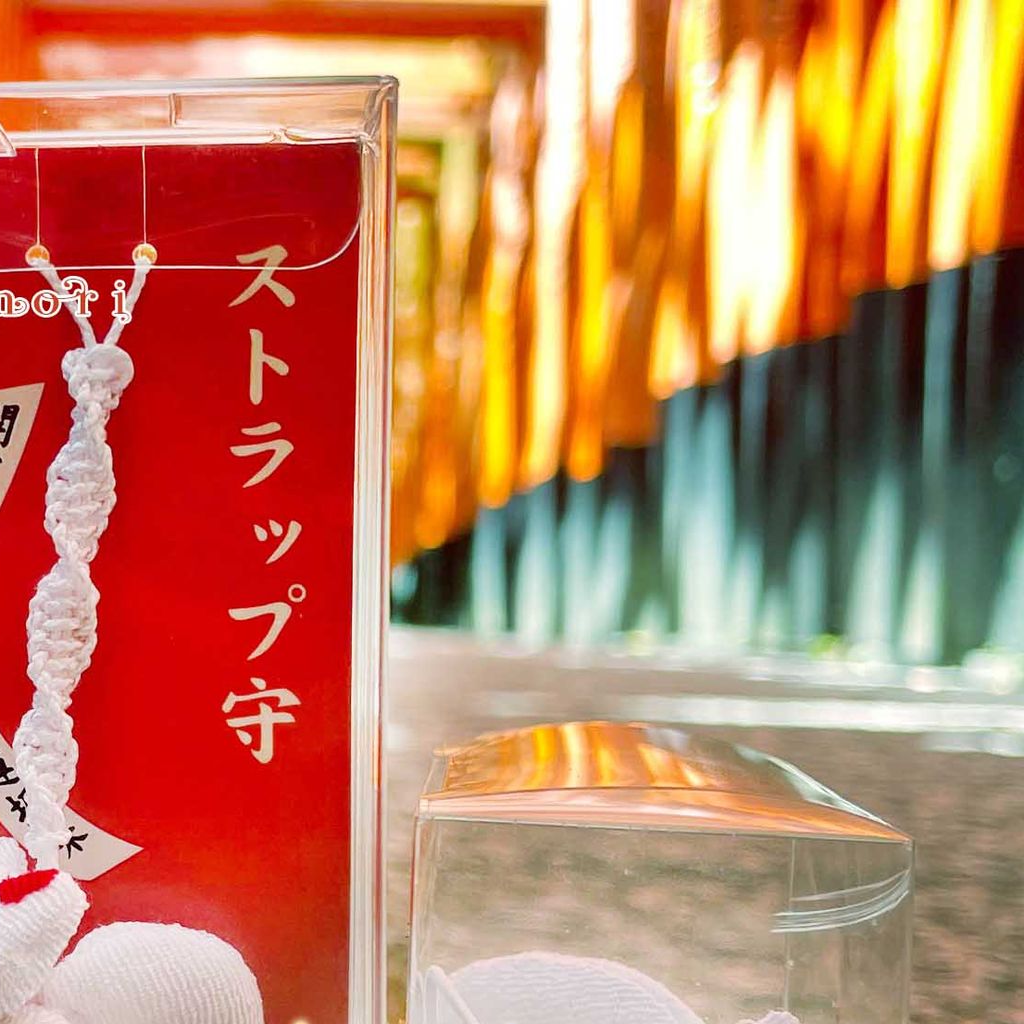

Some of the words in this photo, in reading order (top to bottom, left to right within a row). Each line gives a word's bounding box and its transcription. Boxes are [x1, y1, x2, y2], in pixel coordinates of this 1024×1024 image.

[220, 244, 307, 764] ストラップ守
